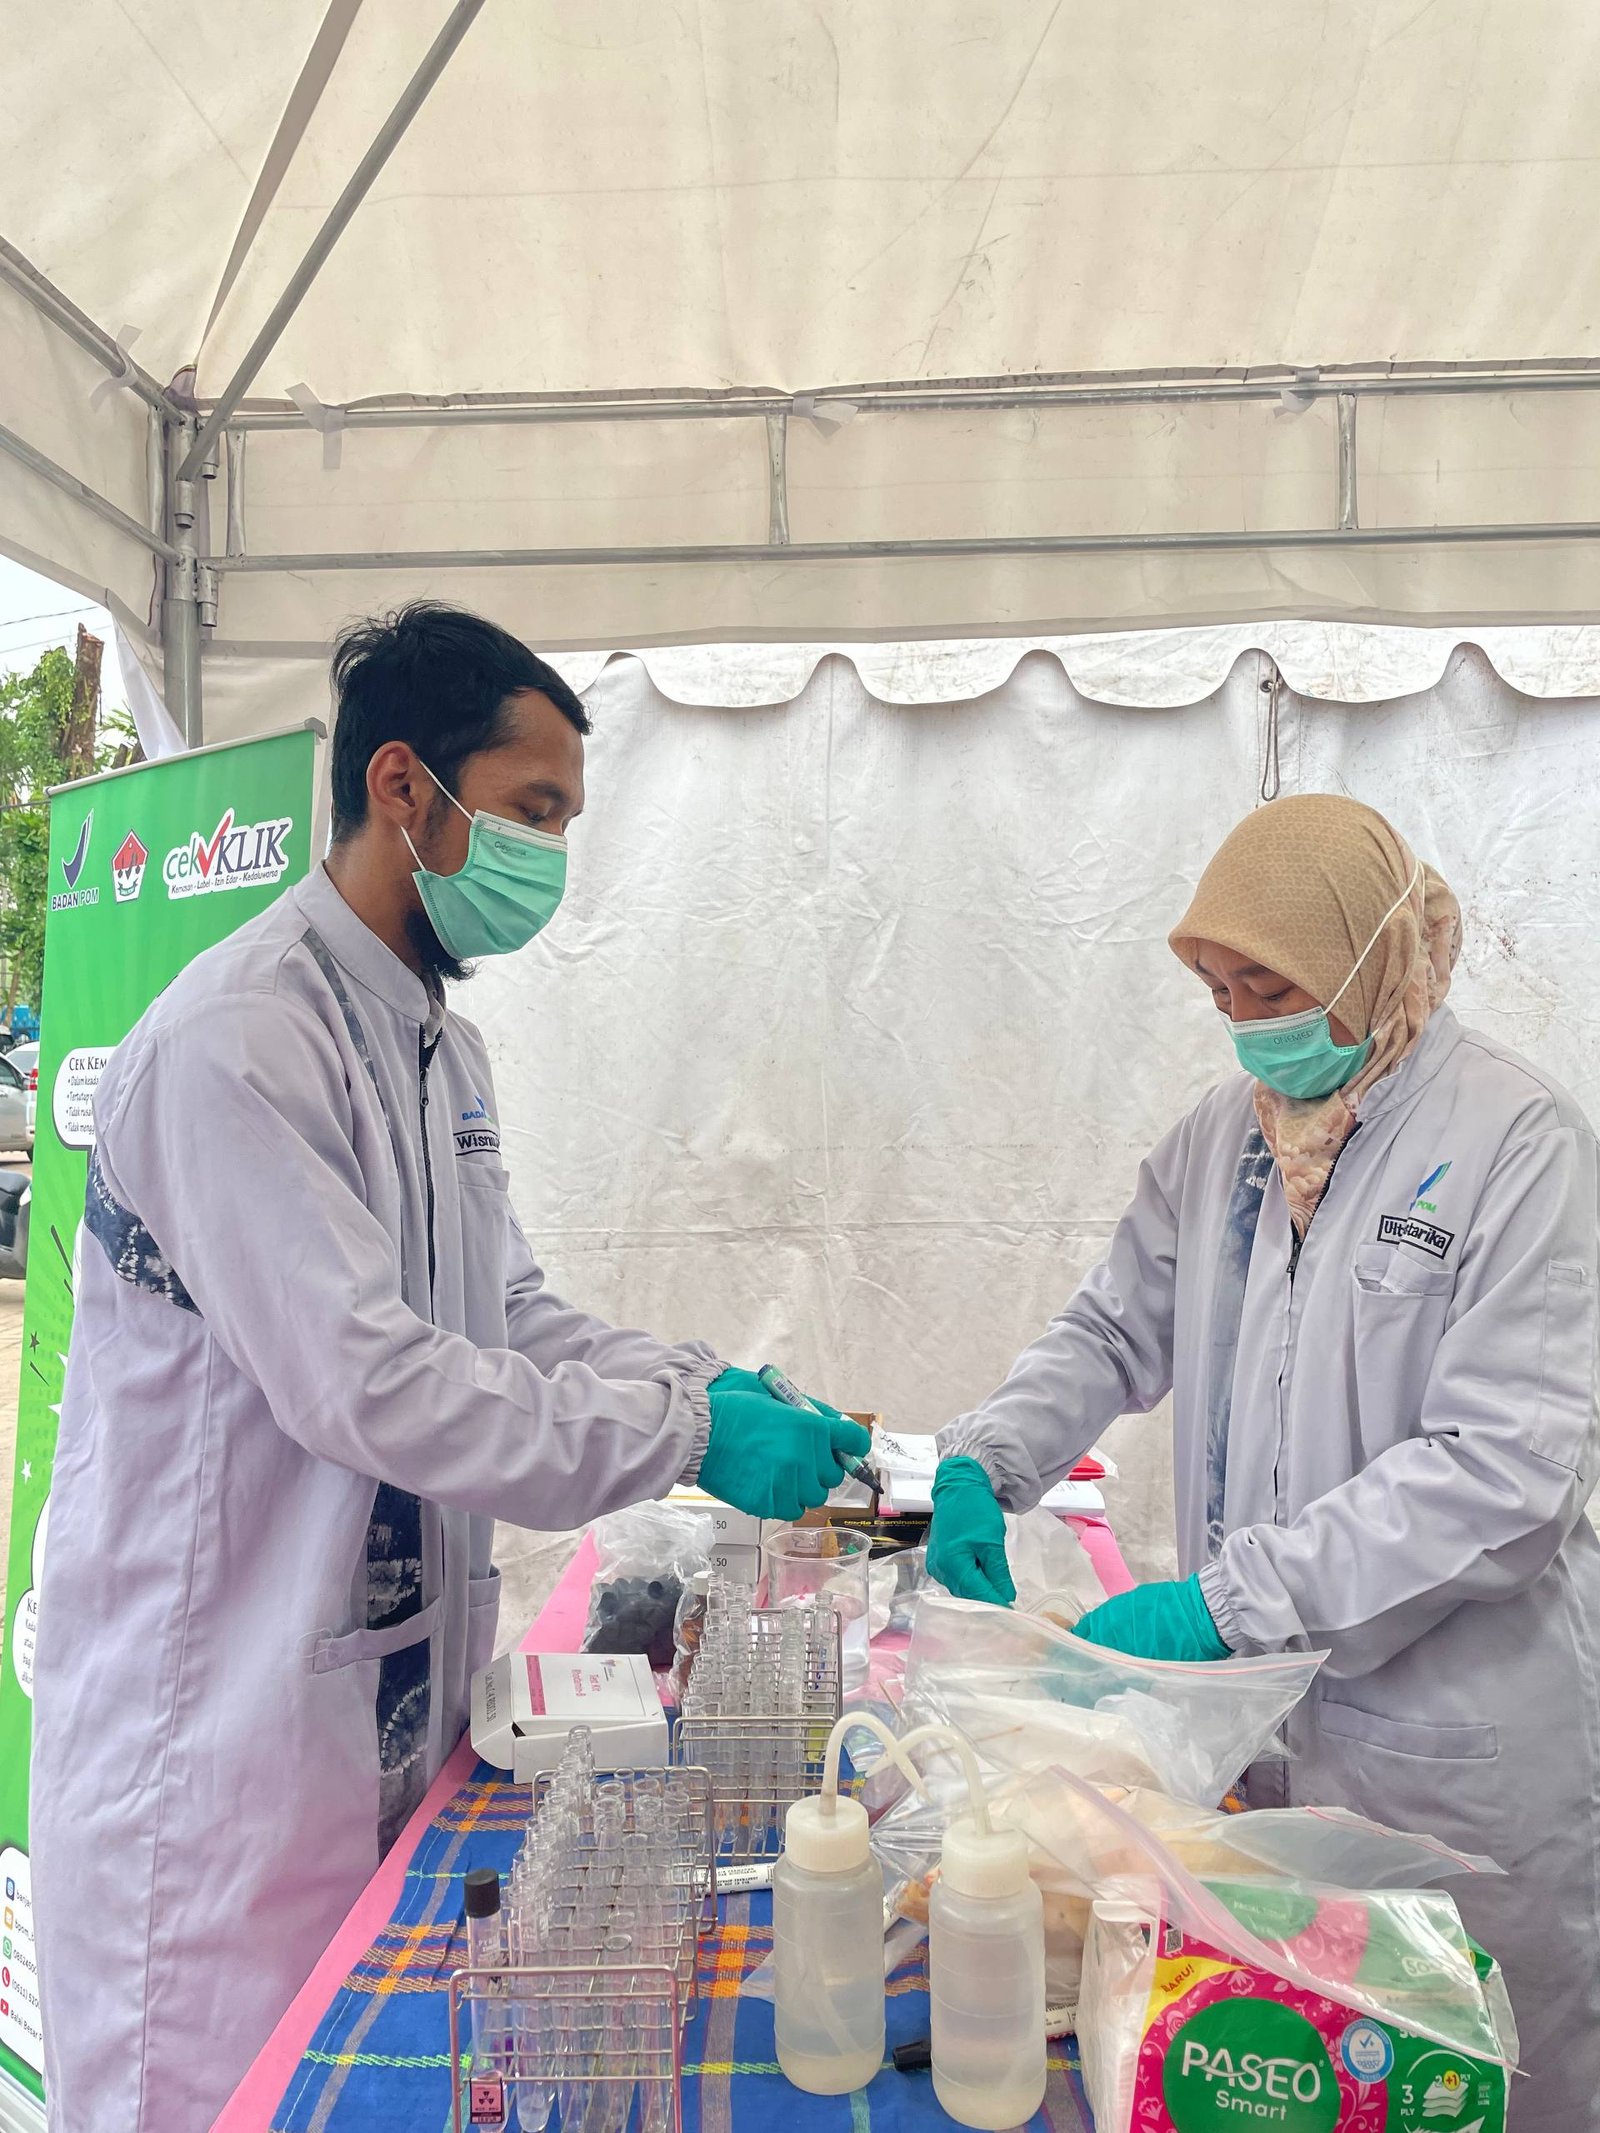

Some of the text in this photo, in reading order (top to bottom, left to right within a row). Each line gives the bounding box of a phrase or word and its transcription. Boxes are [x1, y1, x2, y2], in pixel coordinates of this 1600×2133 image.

[167, 824, 289, 880] cek KLIK
[52, 888, 99, 910] BADAN POM
[87, 1056, 107, 1070] KEM
[1160, 1963, 1195, 1993] BARU!
[1181, 2040, 1321, 2103] PASEO
[1215, 2089, 1287, 2121] Smart
[1401, 2084, 1414, 2105] 3
[1400, 2107, 1416, 2117] PLY
